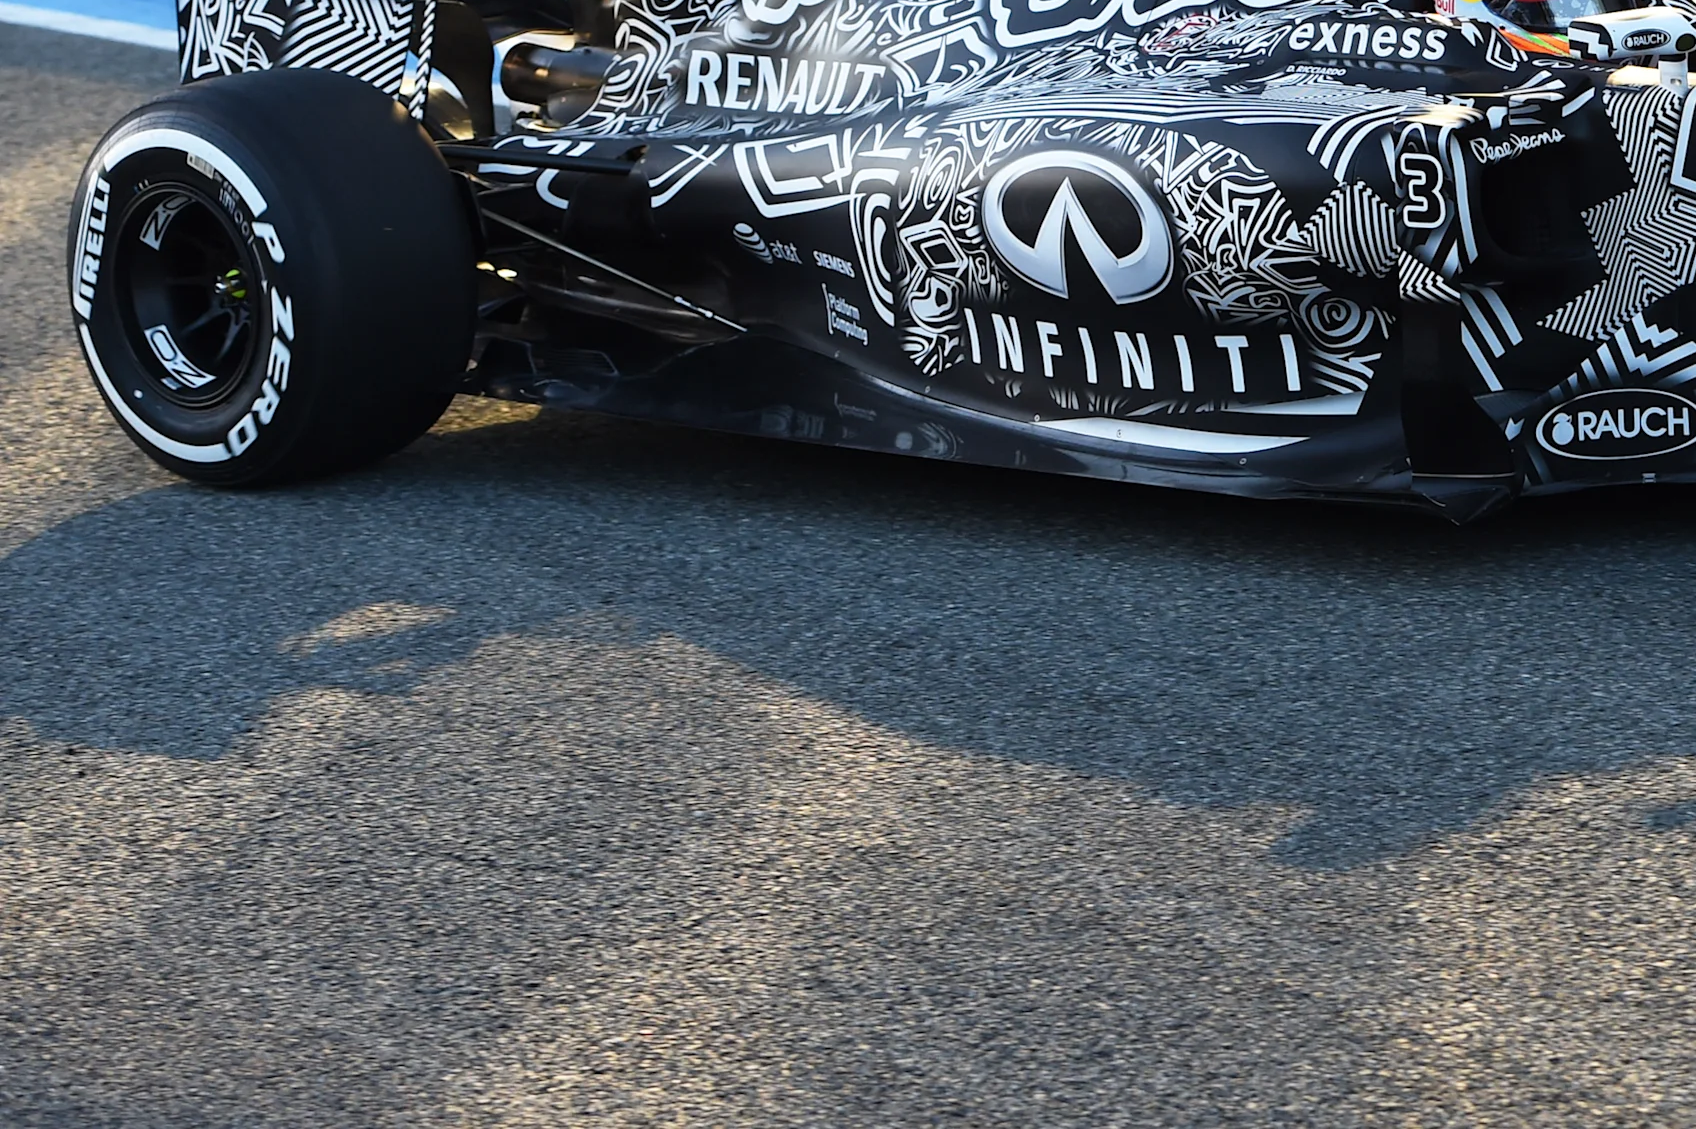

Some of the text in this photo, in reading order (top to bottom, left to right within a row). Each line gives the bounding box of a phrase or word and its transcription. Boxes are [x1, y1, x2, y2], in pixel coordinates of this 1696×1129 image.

[1288, 20, 1449, 61] exness
[1634, 33, 1664, 47] RAUCH
[685, 49, 886, 115] RENAULT
[1296, 65, 1347, 77] RICCIARDO
[1469, 127, 1566, 164] Pepe Jeans
[1400, 153, 1446, 229] 3
[73, 170, 112, 321] PIRELLI
[251, 221, 286, 264] P
[769, 240, 802, 264] at&t
[813, 250, 855, 278] SIEMENS
[963, 308, 1303, 392] INFINITI
[224, 285, 295, 458] ZERO
[1577, 406, 1691, 442] RAUCH
